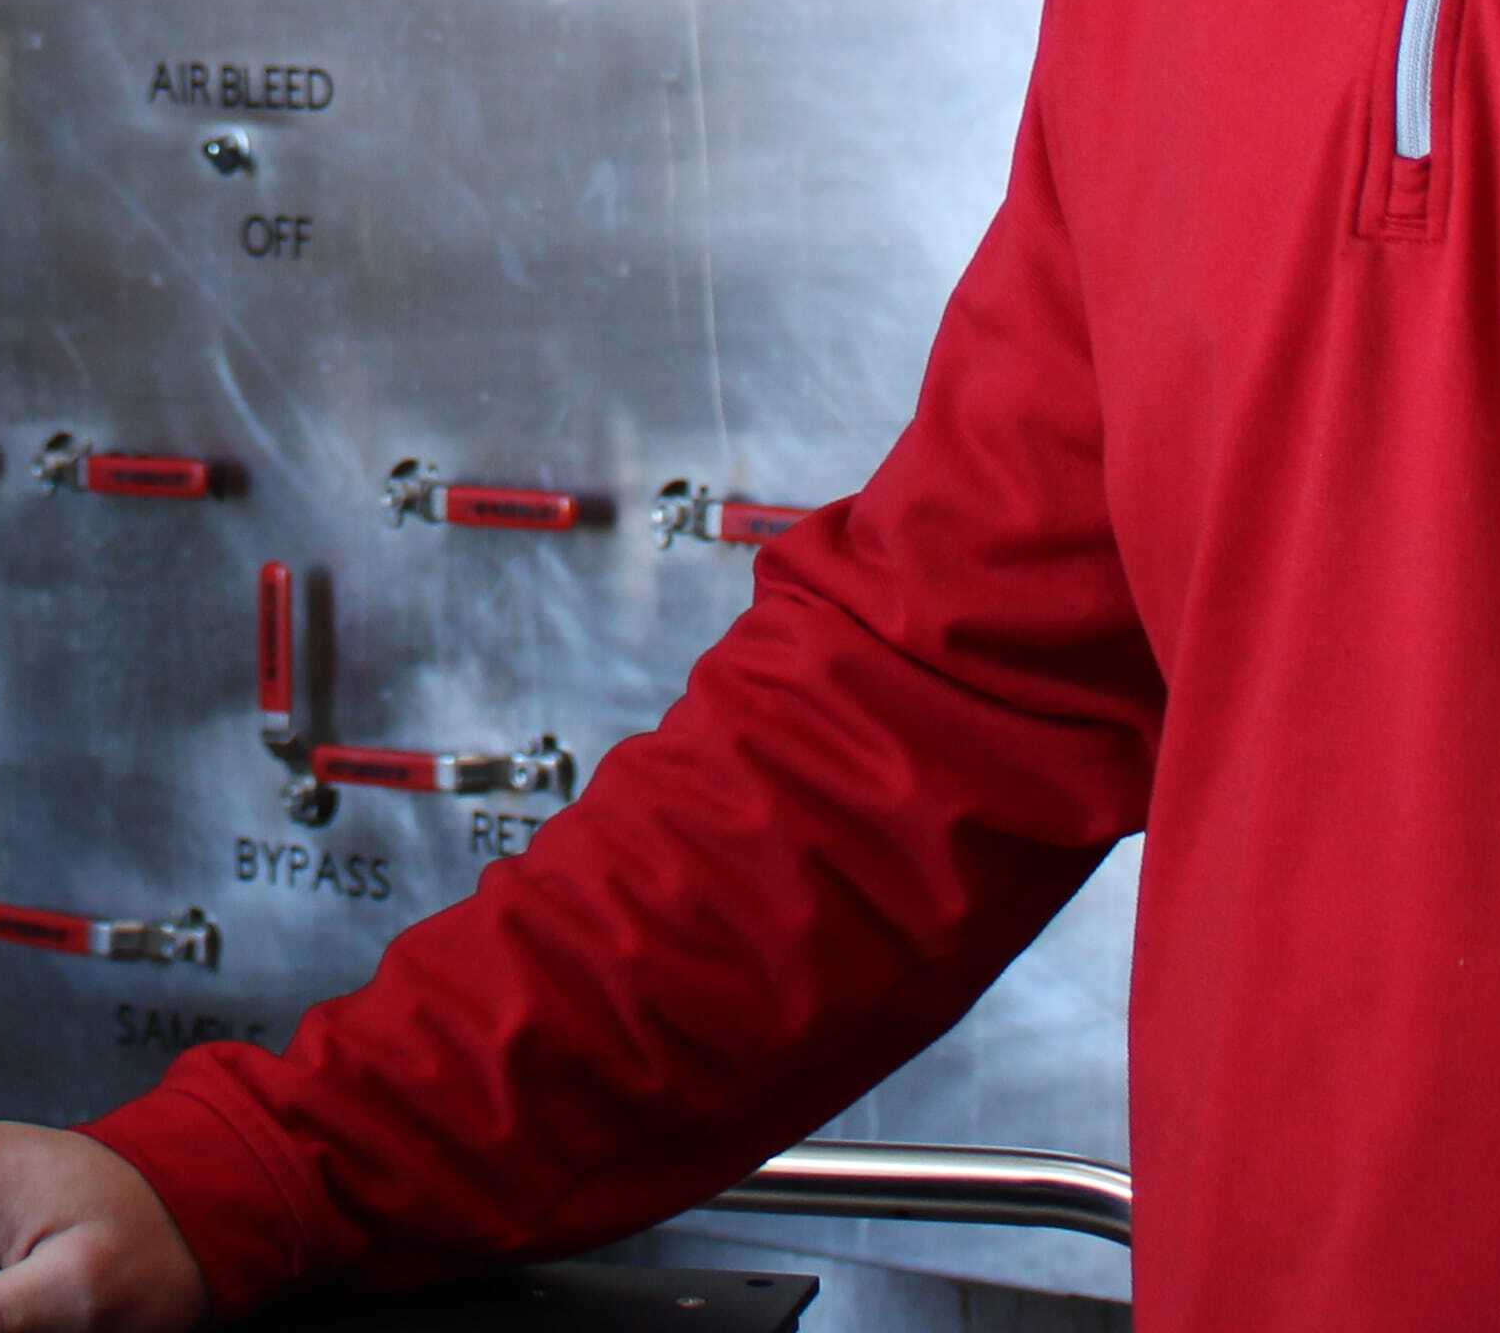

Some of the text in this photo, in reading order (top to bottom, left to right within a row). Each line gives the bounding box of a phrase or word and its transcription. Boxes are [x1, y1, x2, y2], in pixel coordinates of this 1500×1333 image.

[147, 61, 335, 111] AIR BLEED
[242, 213, 313, 259] OFF
[235, 838, 391, 901] BYPASS
